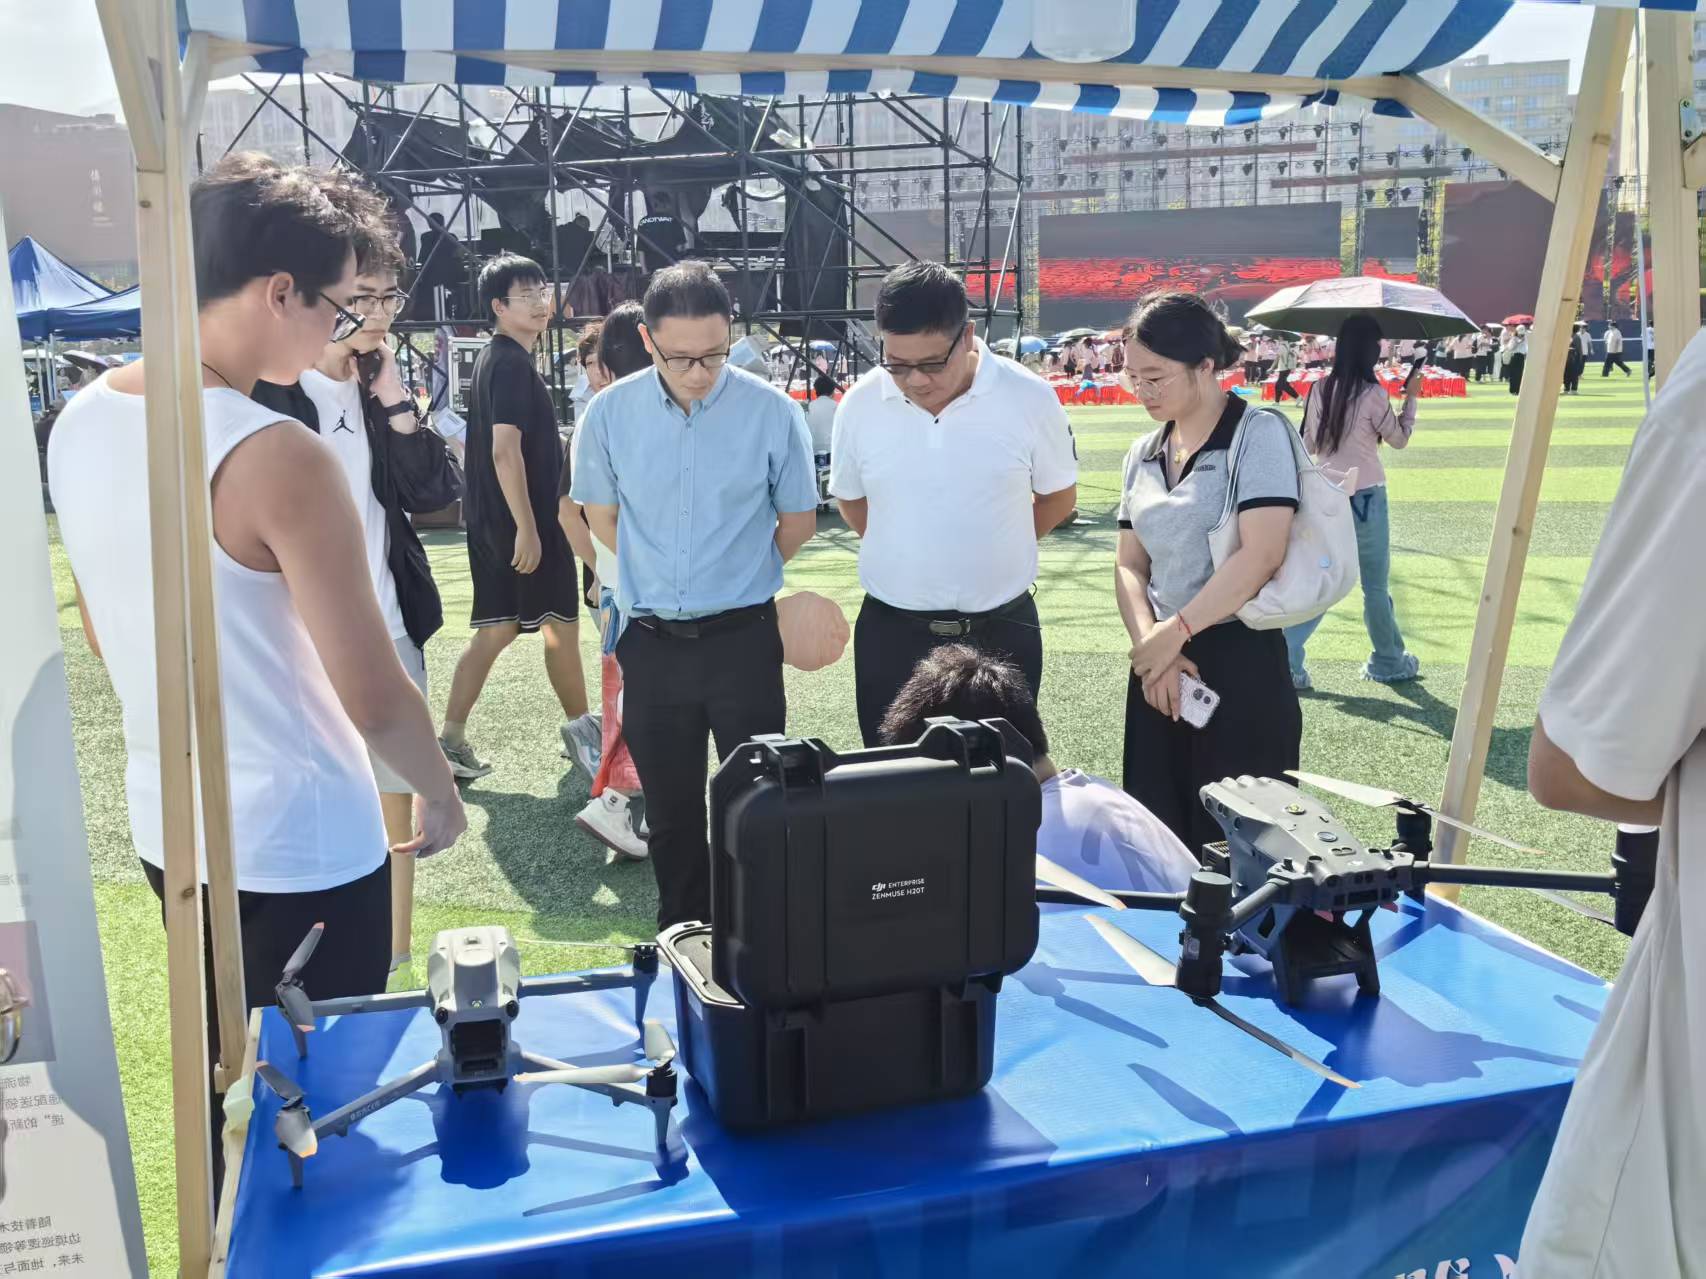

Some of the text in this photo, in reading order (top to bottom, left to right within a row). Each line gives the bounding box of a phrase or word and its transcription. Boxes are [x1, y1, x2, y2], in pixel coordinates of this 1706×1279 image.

[888, 878, 925, 889] ENTERPRISE
[871, 886, 925, 900] ZENMUSE H20T
